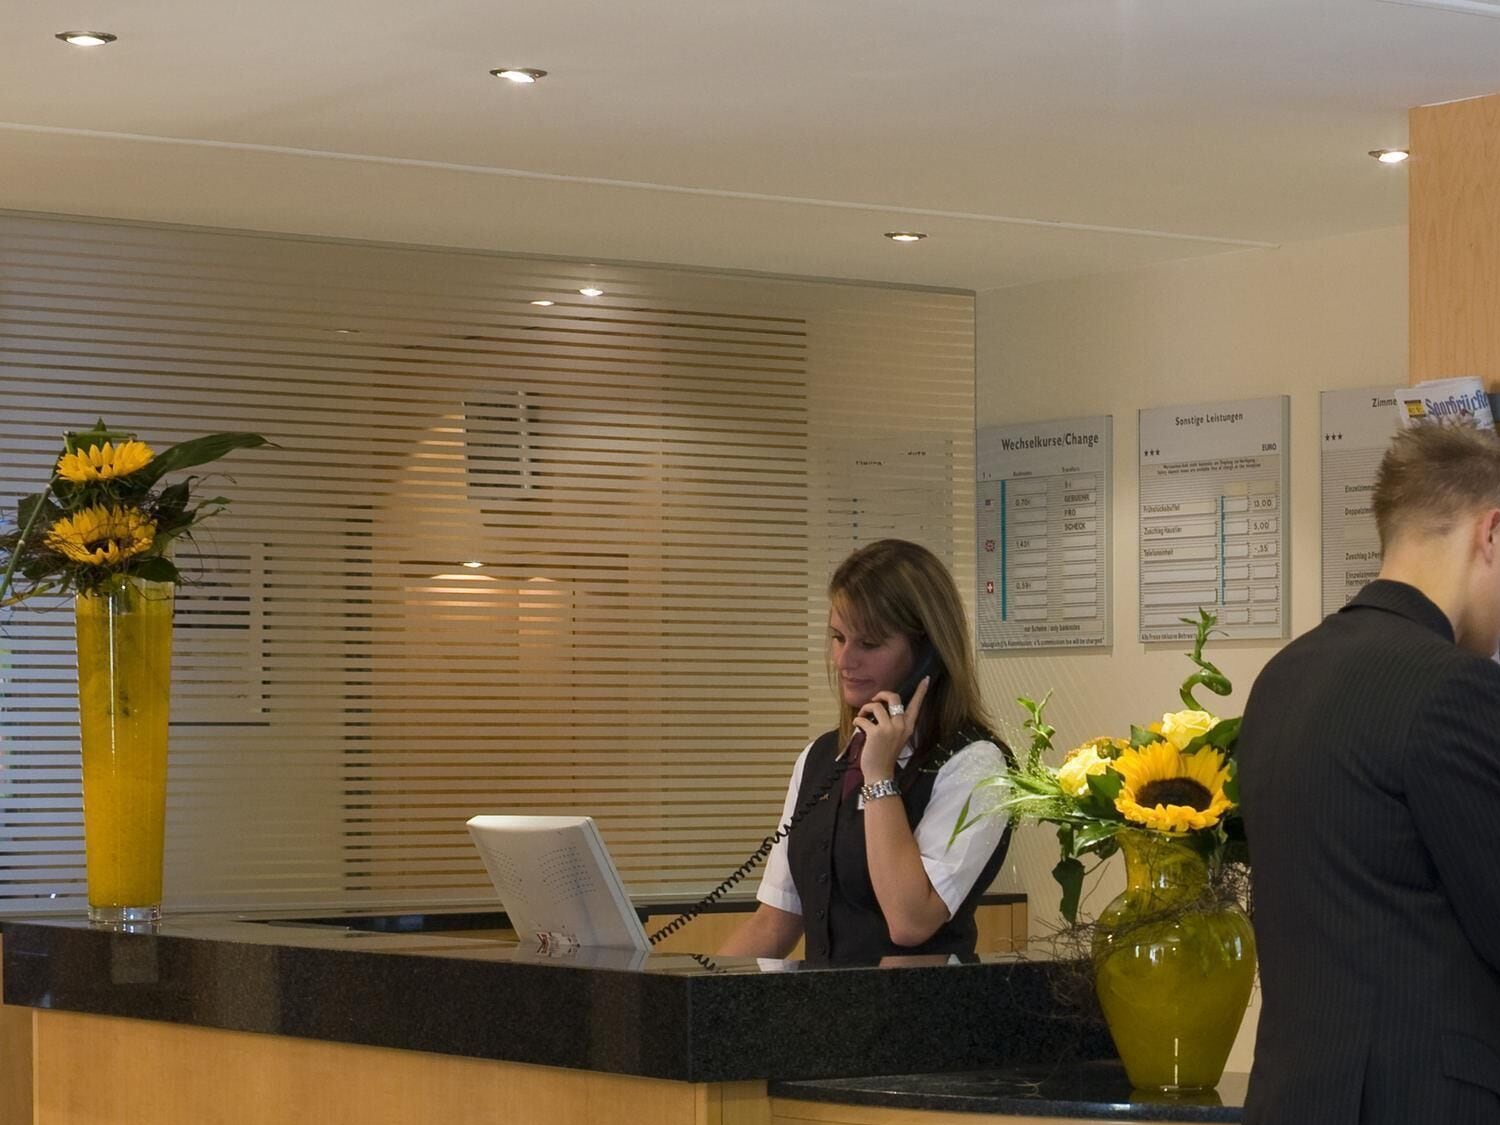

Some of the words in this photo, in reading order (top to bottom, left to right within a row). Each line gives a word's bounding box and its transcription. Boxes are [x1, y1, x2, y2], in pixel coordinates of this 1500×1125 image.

[1371, 397, 1398, 408] Zimme
[1425, 389, 1489, 418] Saarbrücke
[1175, 415, 1204, 427] Sonstige
[1206, 412, 1244, 424] Leistungen
[1001, 432, 1099, 451] Wechselkurse/Change
[1261, 442, 1277, 452] EURO
[1063, 508, 1077, 518] PRO
